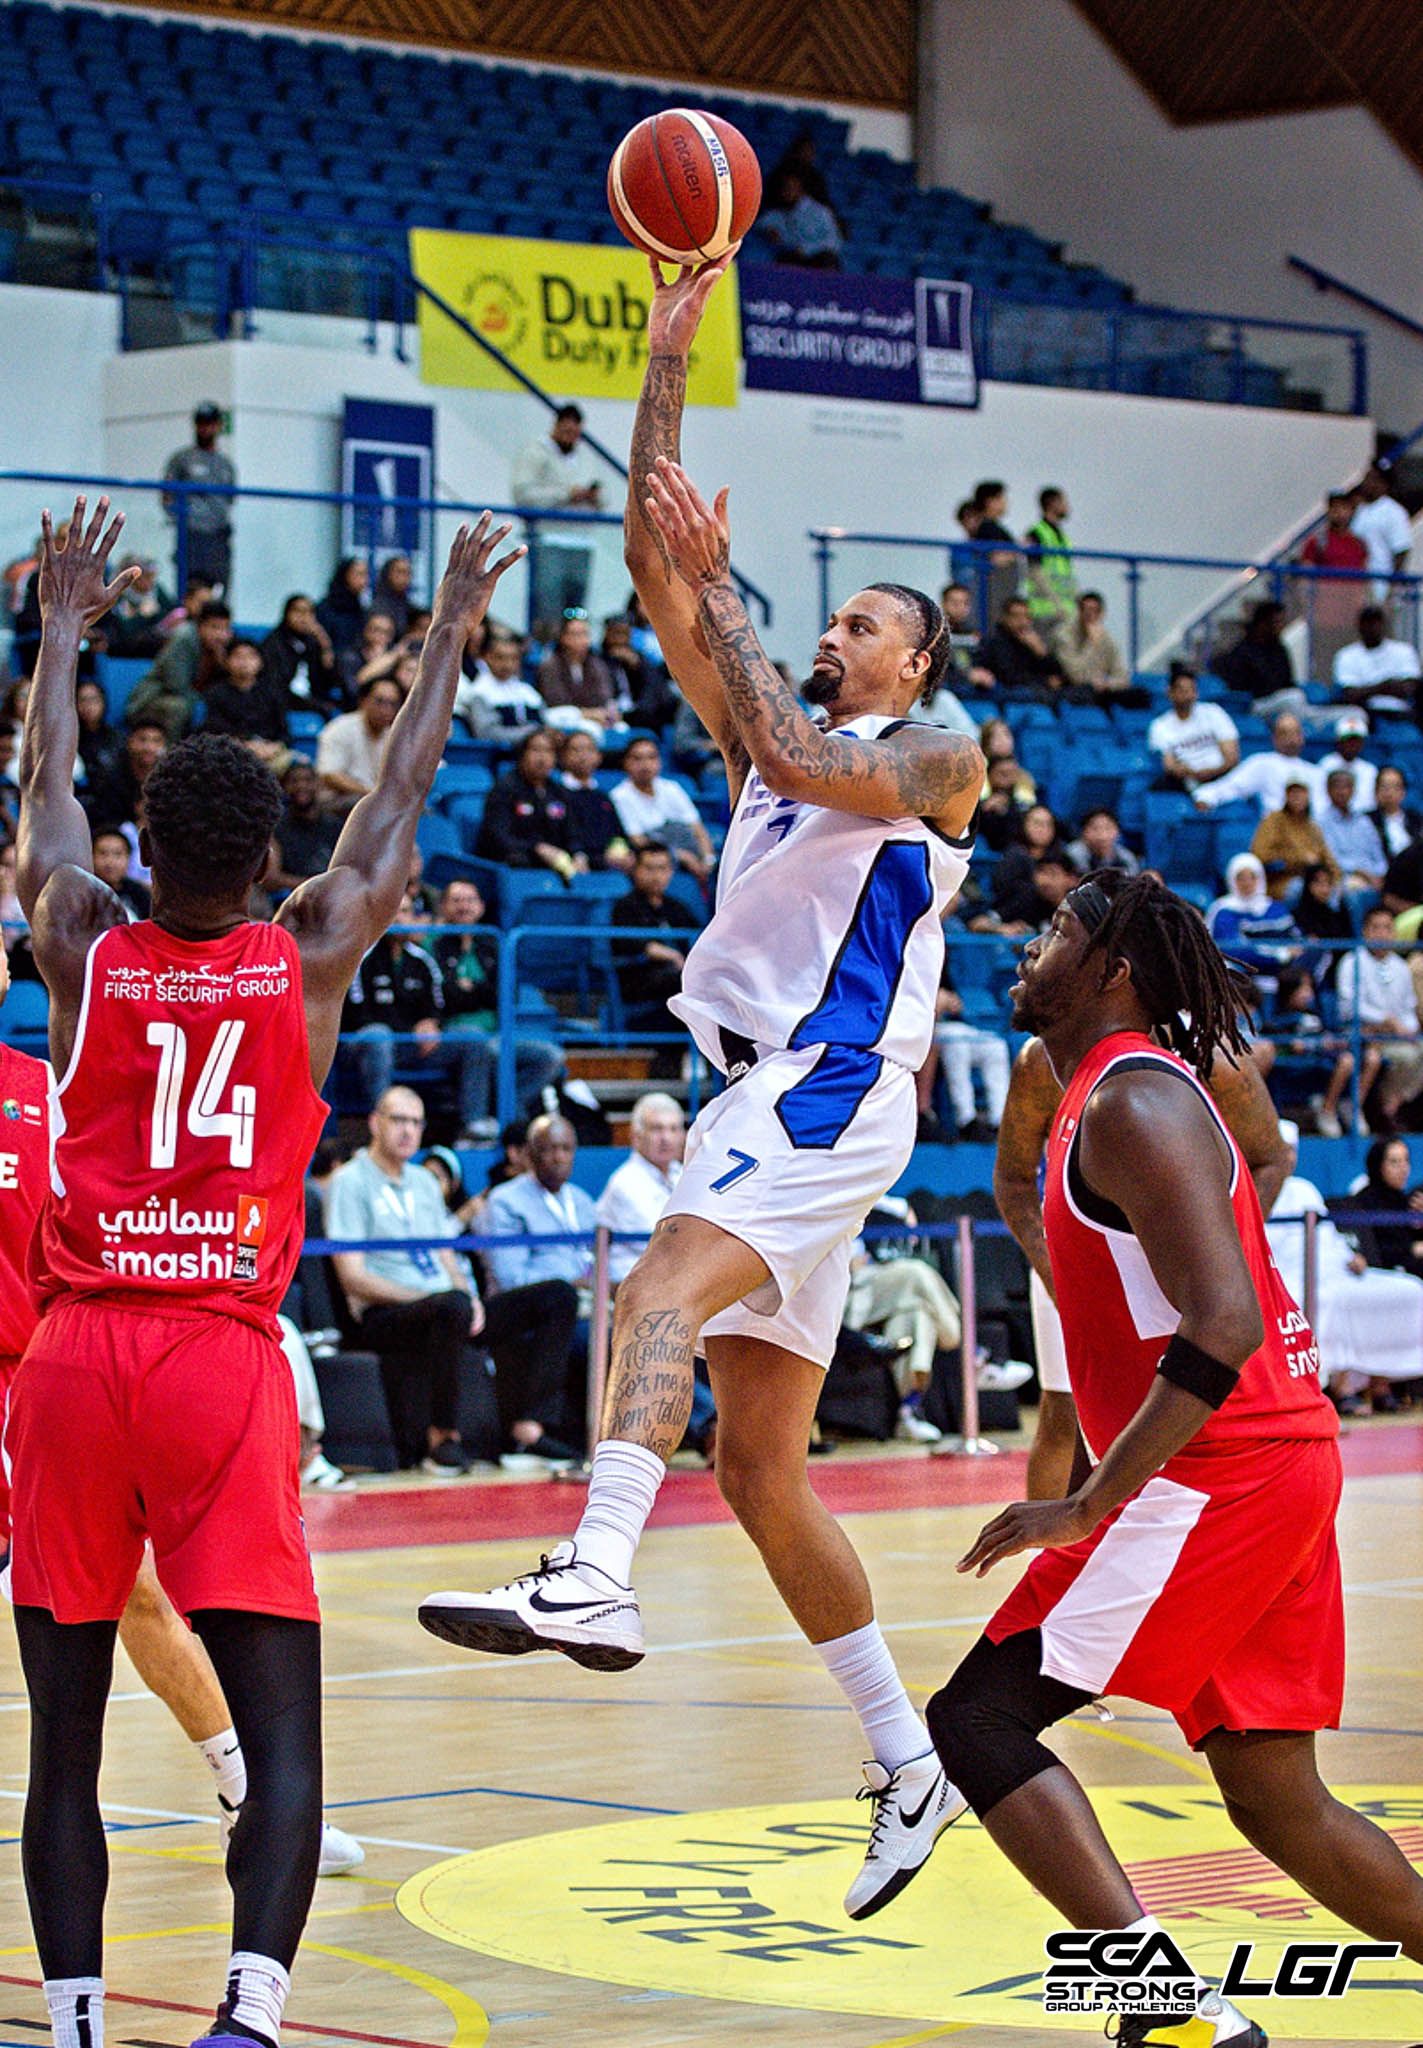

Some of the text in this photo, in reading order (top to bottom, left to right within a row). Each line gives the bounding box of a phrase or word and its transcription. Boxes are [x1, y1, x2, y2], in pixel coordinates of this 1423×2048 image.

[672, 134, 702, 200] molten
[540, 273, 648, 332] Dub
[543, 327, 620, 374] Duty
[103, 977, 290, 1004] FIRST SECURITY GROUP
[146, 1019, 257, 1170] 14
[708, 1147, 761, 1195] 7
[97, 1194, 236, 1244] سماشي
[101, 1241, 235, 1280] smashi
[634, 1307, 689, 1340] The
[568, 1886, 924, 1964] FREE
